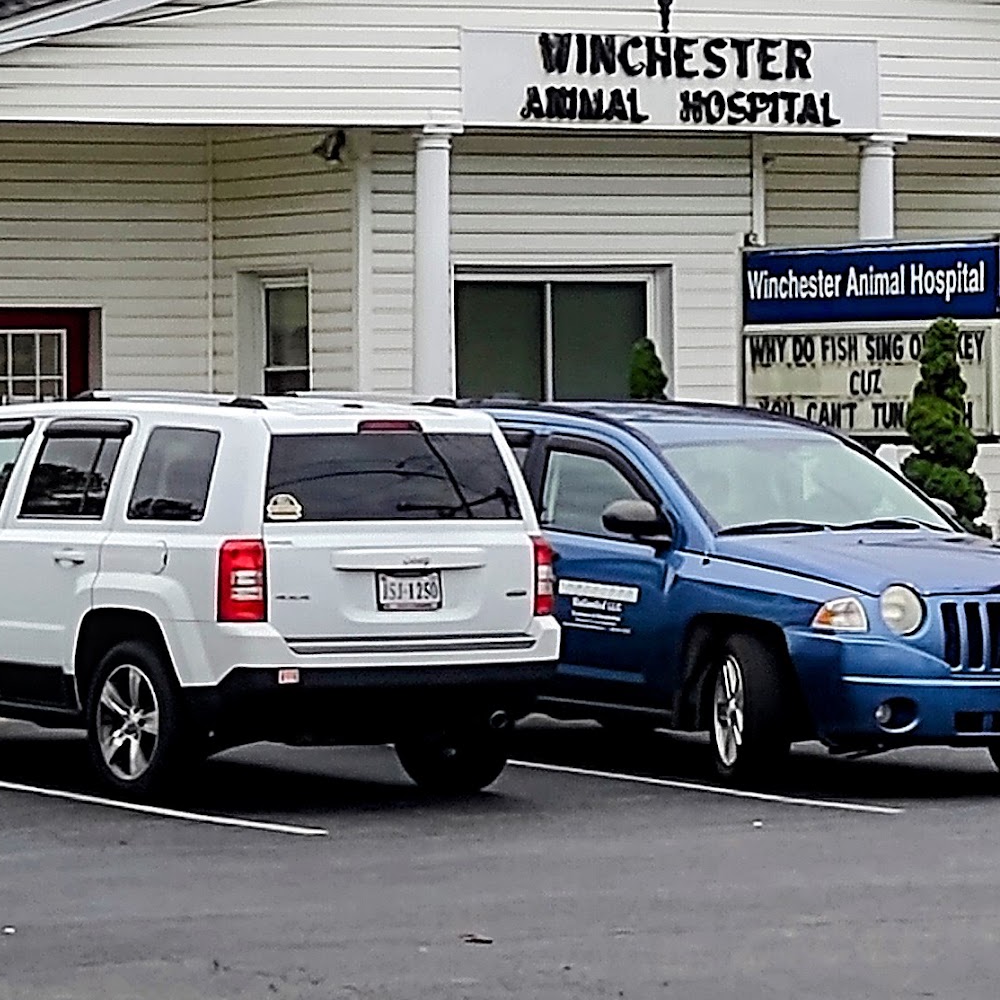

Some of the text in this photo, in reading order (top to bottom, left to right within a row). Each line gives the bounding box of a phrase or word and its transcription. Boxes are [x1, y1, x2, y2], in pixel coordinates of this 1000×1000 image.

[539, 32, 812, 79] WINCHESTER
[679, 90, 841, 127] HOSPITAL
[747, 259, 985, 302] Winchester Animal Hospital
[750, 335, 786, 364] WHY
[792, 335, 815, 362] DO
[821, 334, 858, 362] FISH
[865, 333, 904, 361] SING
[849, 369, 882, 395] CUZ
[872, 401, 905, 429] TUN
